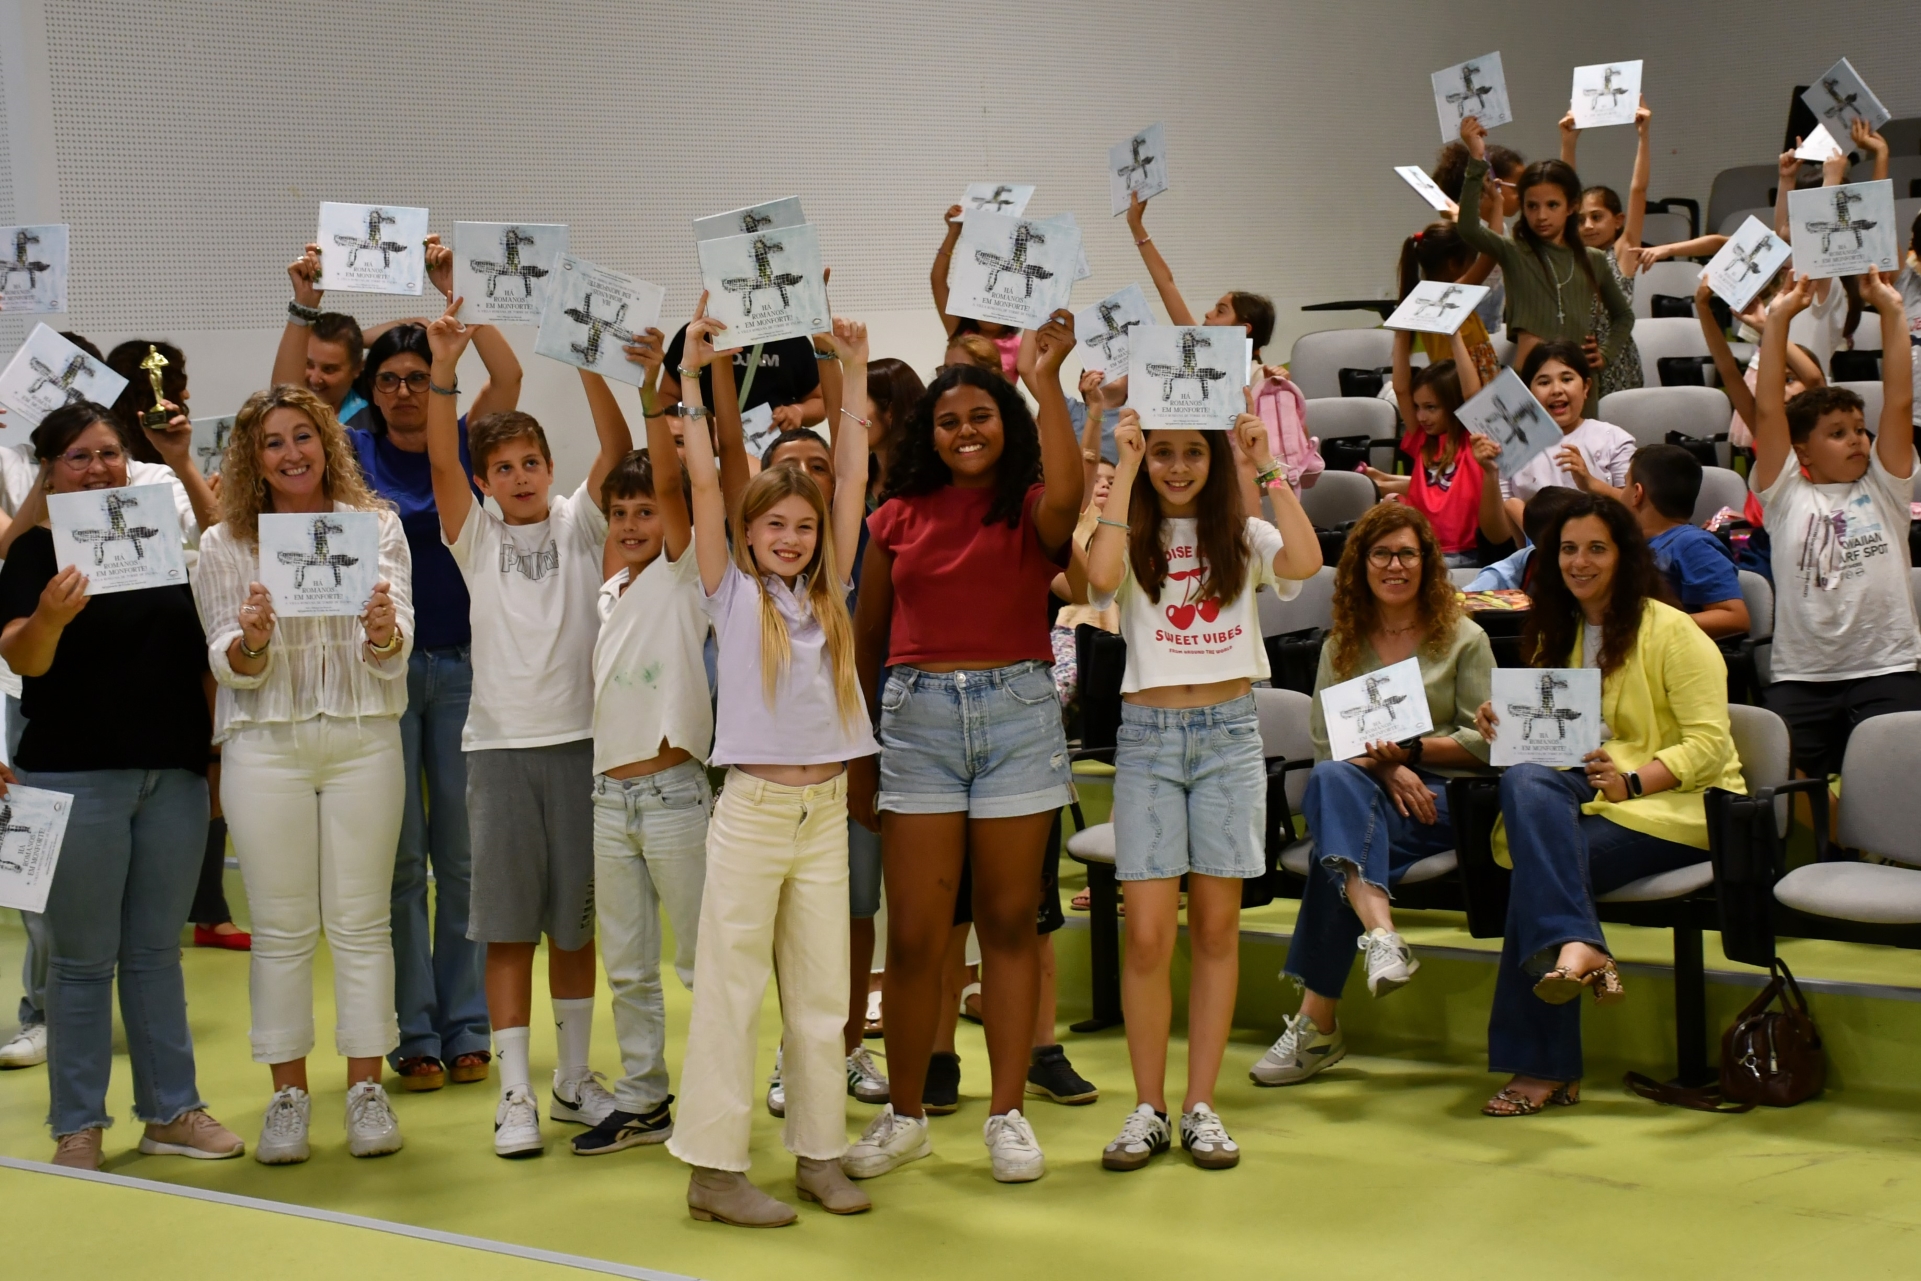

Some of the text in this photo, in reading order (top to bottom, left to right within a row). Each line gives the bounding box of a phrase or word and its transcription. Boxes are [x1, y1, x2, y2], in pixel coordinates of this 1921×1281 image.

[991, 292, 1024, 303] ROMANOS
[752, 310, 785, 319] ROMANOS
[1863, 543, 1888, 558] SPOT
[104, 561, 138, 569] ROMANOS
[1156, 624, 1242, 645] SWEET VIBES
[22, 833, 36, 867] ROMANOS
[28, 865, 35, 876] EM
